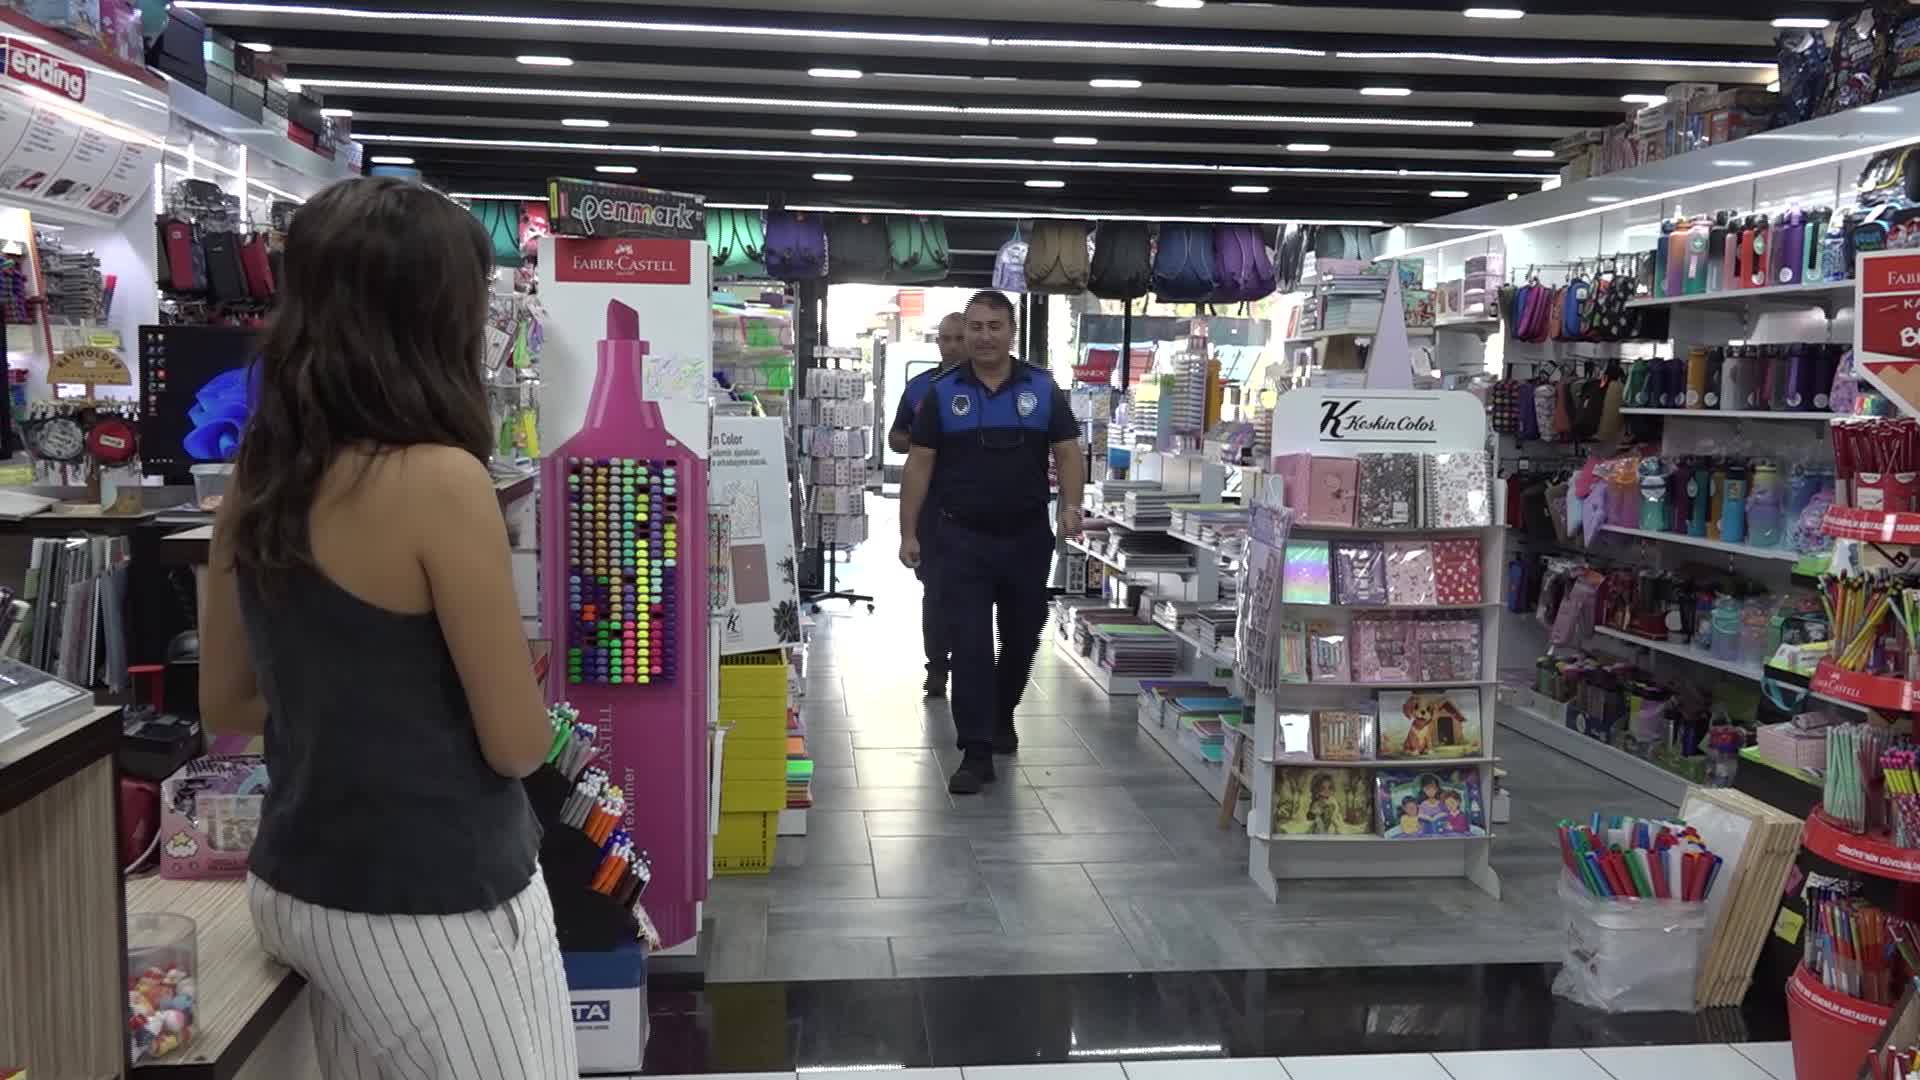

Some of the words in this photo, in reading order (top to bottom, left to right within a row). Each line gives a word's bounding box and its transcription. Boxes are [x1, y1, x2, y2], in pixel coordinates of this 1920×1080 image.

[10, 49, 83, 100] edding
[573, 255, 677, 272] FABER-CASTELL
[1343, 415, 1396, 432] Keskin
[1396, 415, 1438, 432] Color
[720, 432, 743, 446] Color
[623, 767, 636, 832] Textliner
[571, 1003, 607, 1020] TA
